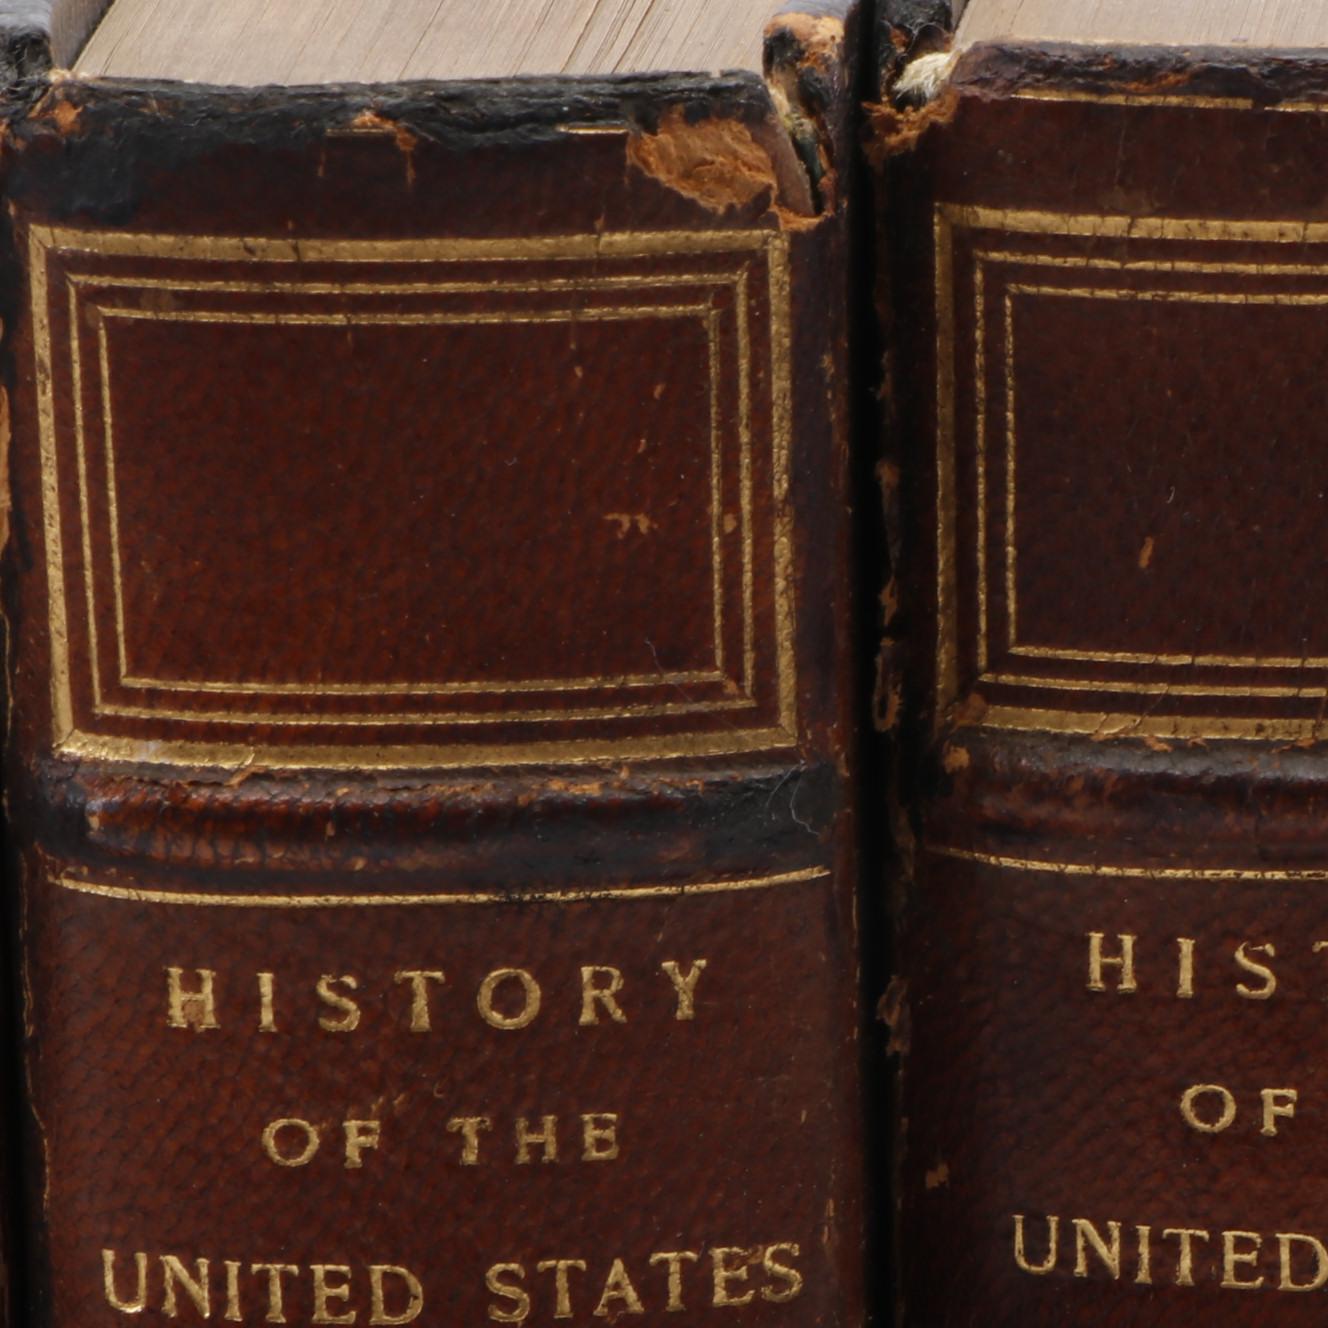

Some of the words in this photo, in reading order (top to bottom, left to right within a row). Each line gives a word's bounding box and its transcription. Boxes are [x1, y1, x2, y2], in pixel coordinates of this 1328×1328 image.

[165, 958, 708, 1033] HISTORY
[261, 1116, 382, 1168] OF
[449, 1111, 619, 1166] THE
[1179, 1082, 1299, 1137] OF
[100, 1247, 425, 1326] UNITED
[485, 1243, 803, 1323] STATES
